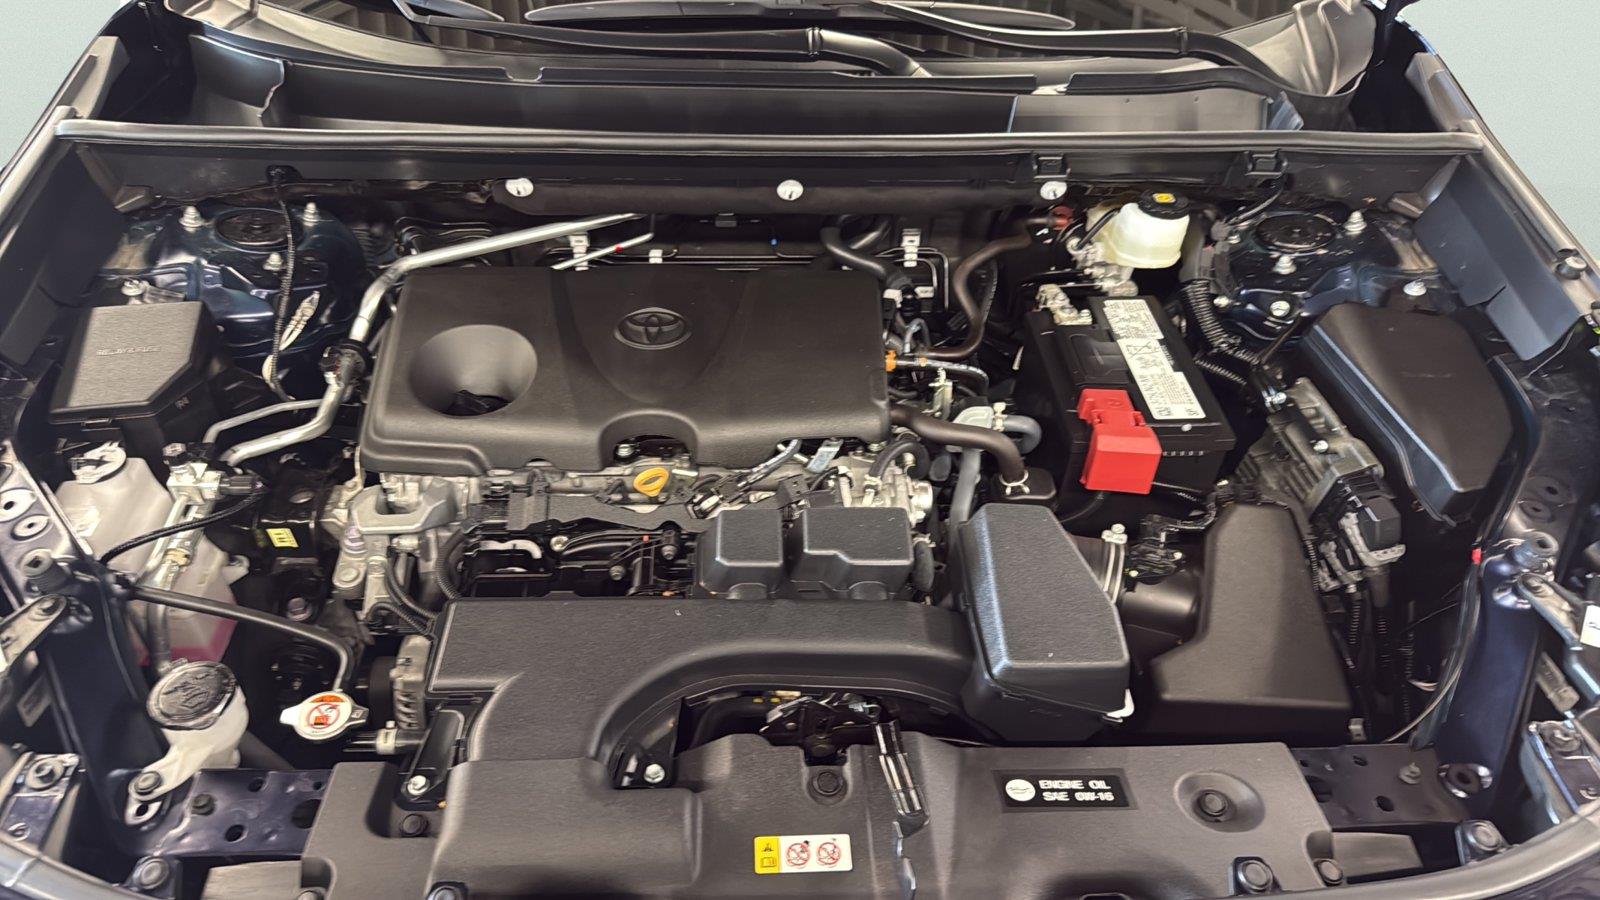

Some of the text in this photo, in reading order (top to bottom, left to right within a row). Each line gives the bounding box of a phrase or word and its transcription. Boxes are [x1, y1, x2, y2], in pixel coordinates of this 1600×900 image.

[1038, 780, 1112, 790] ENGINE OIL
[1042, 791, 1070, 801] SAE
